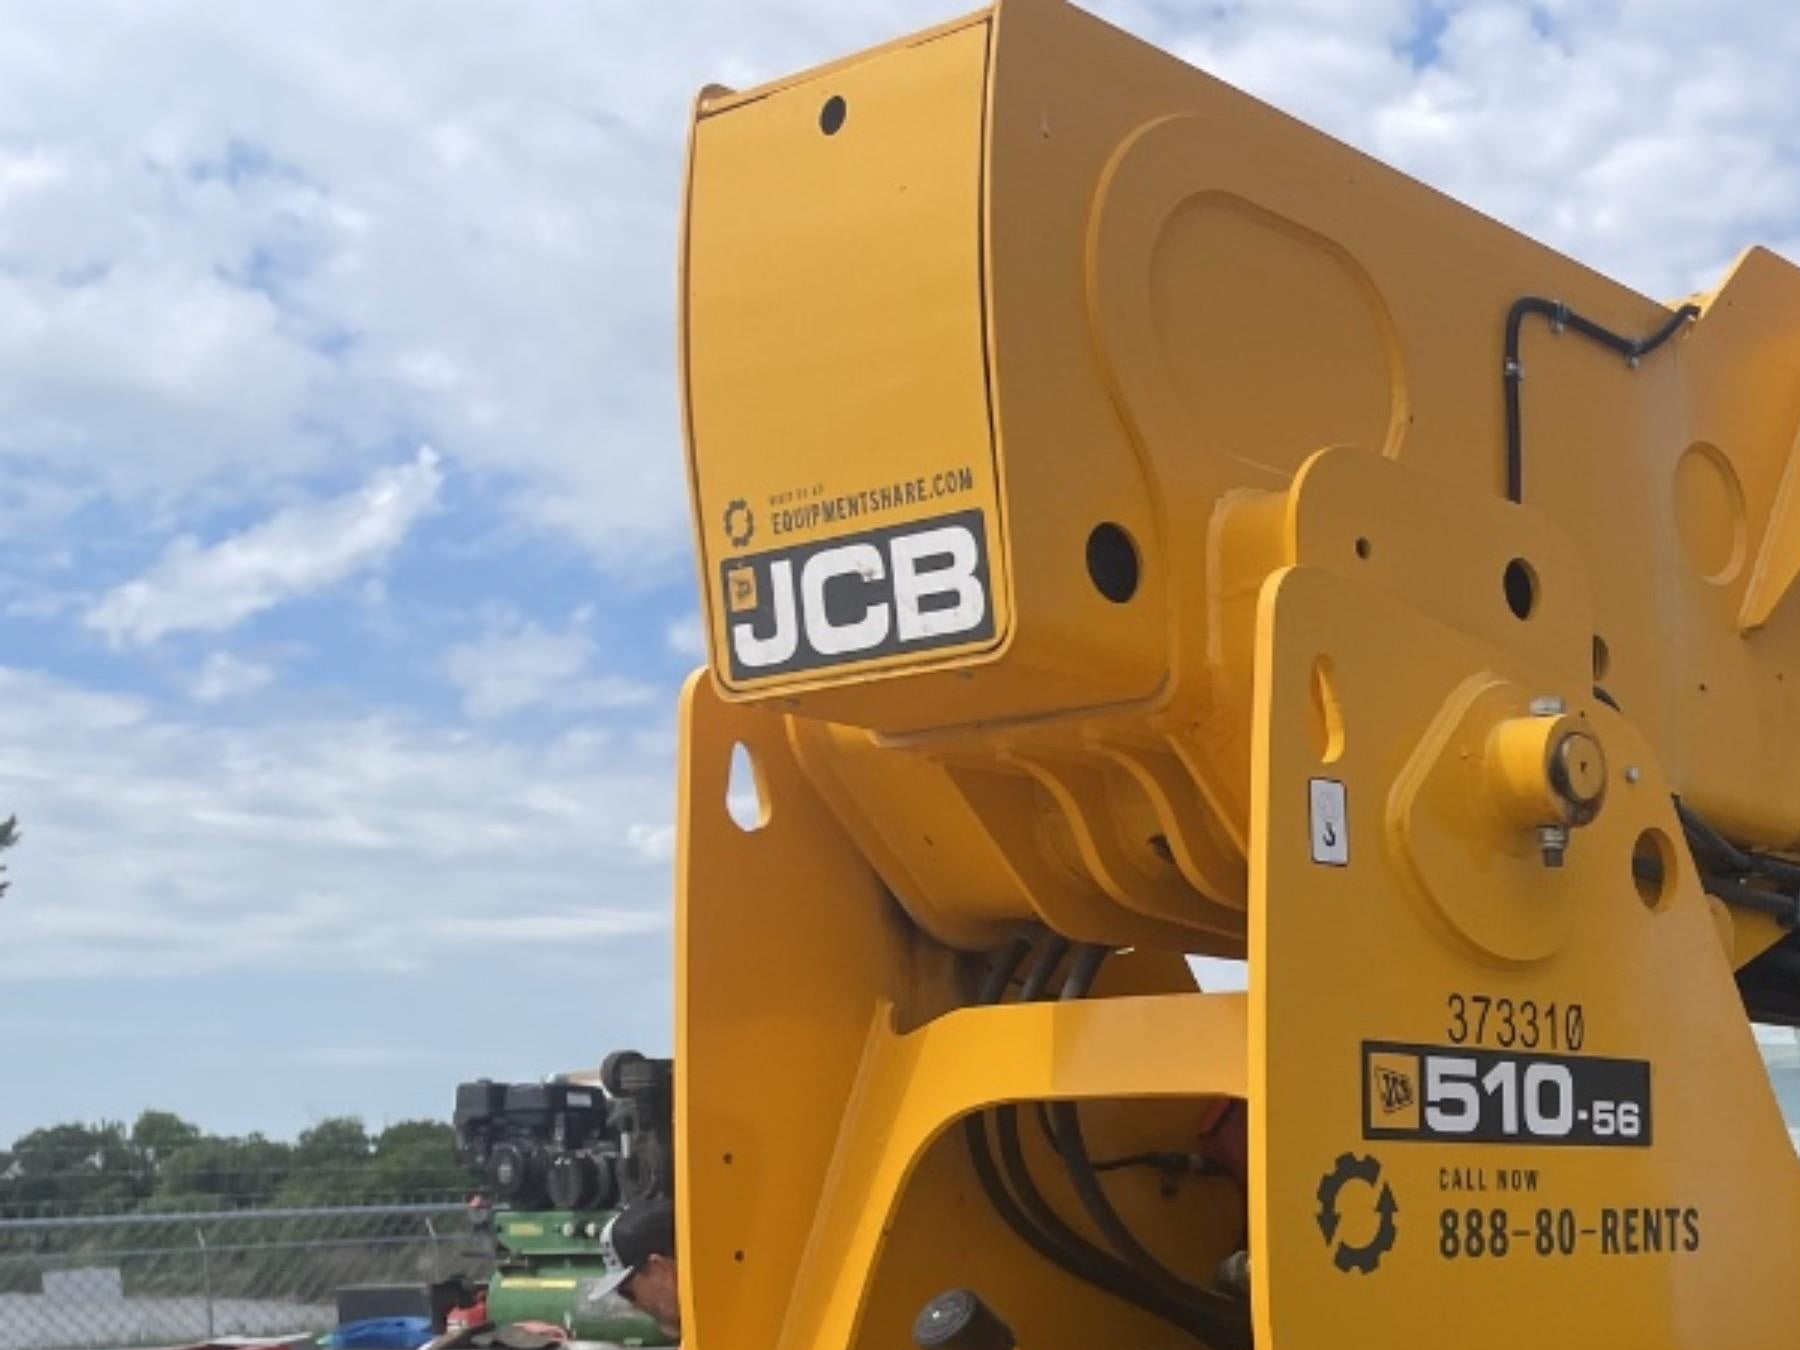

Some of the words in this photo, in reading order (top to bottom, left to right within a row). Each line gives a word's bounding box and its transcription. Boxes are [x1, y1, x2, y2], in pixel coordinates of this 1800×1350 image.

[770, 466, 973, 535] EQUIPMENTSHARE.COM
[733, 525, 985, 668] JCB
[1447, 993, 1586, 1051] 373310
[1438, 1167, 1487, 1192] CALL
[1497, 1168, 1540, 1191] NOW
[1438, 1207, 1701, 1260] 888-80-RENTS
